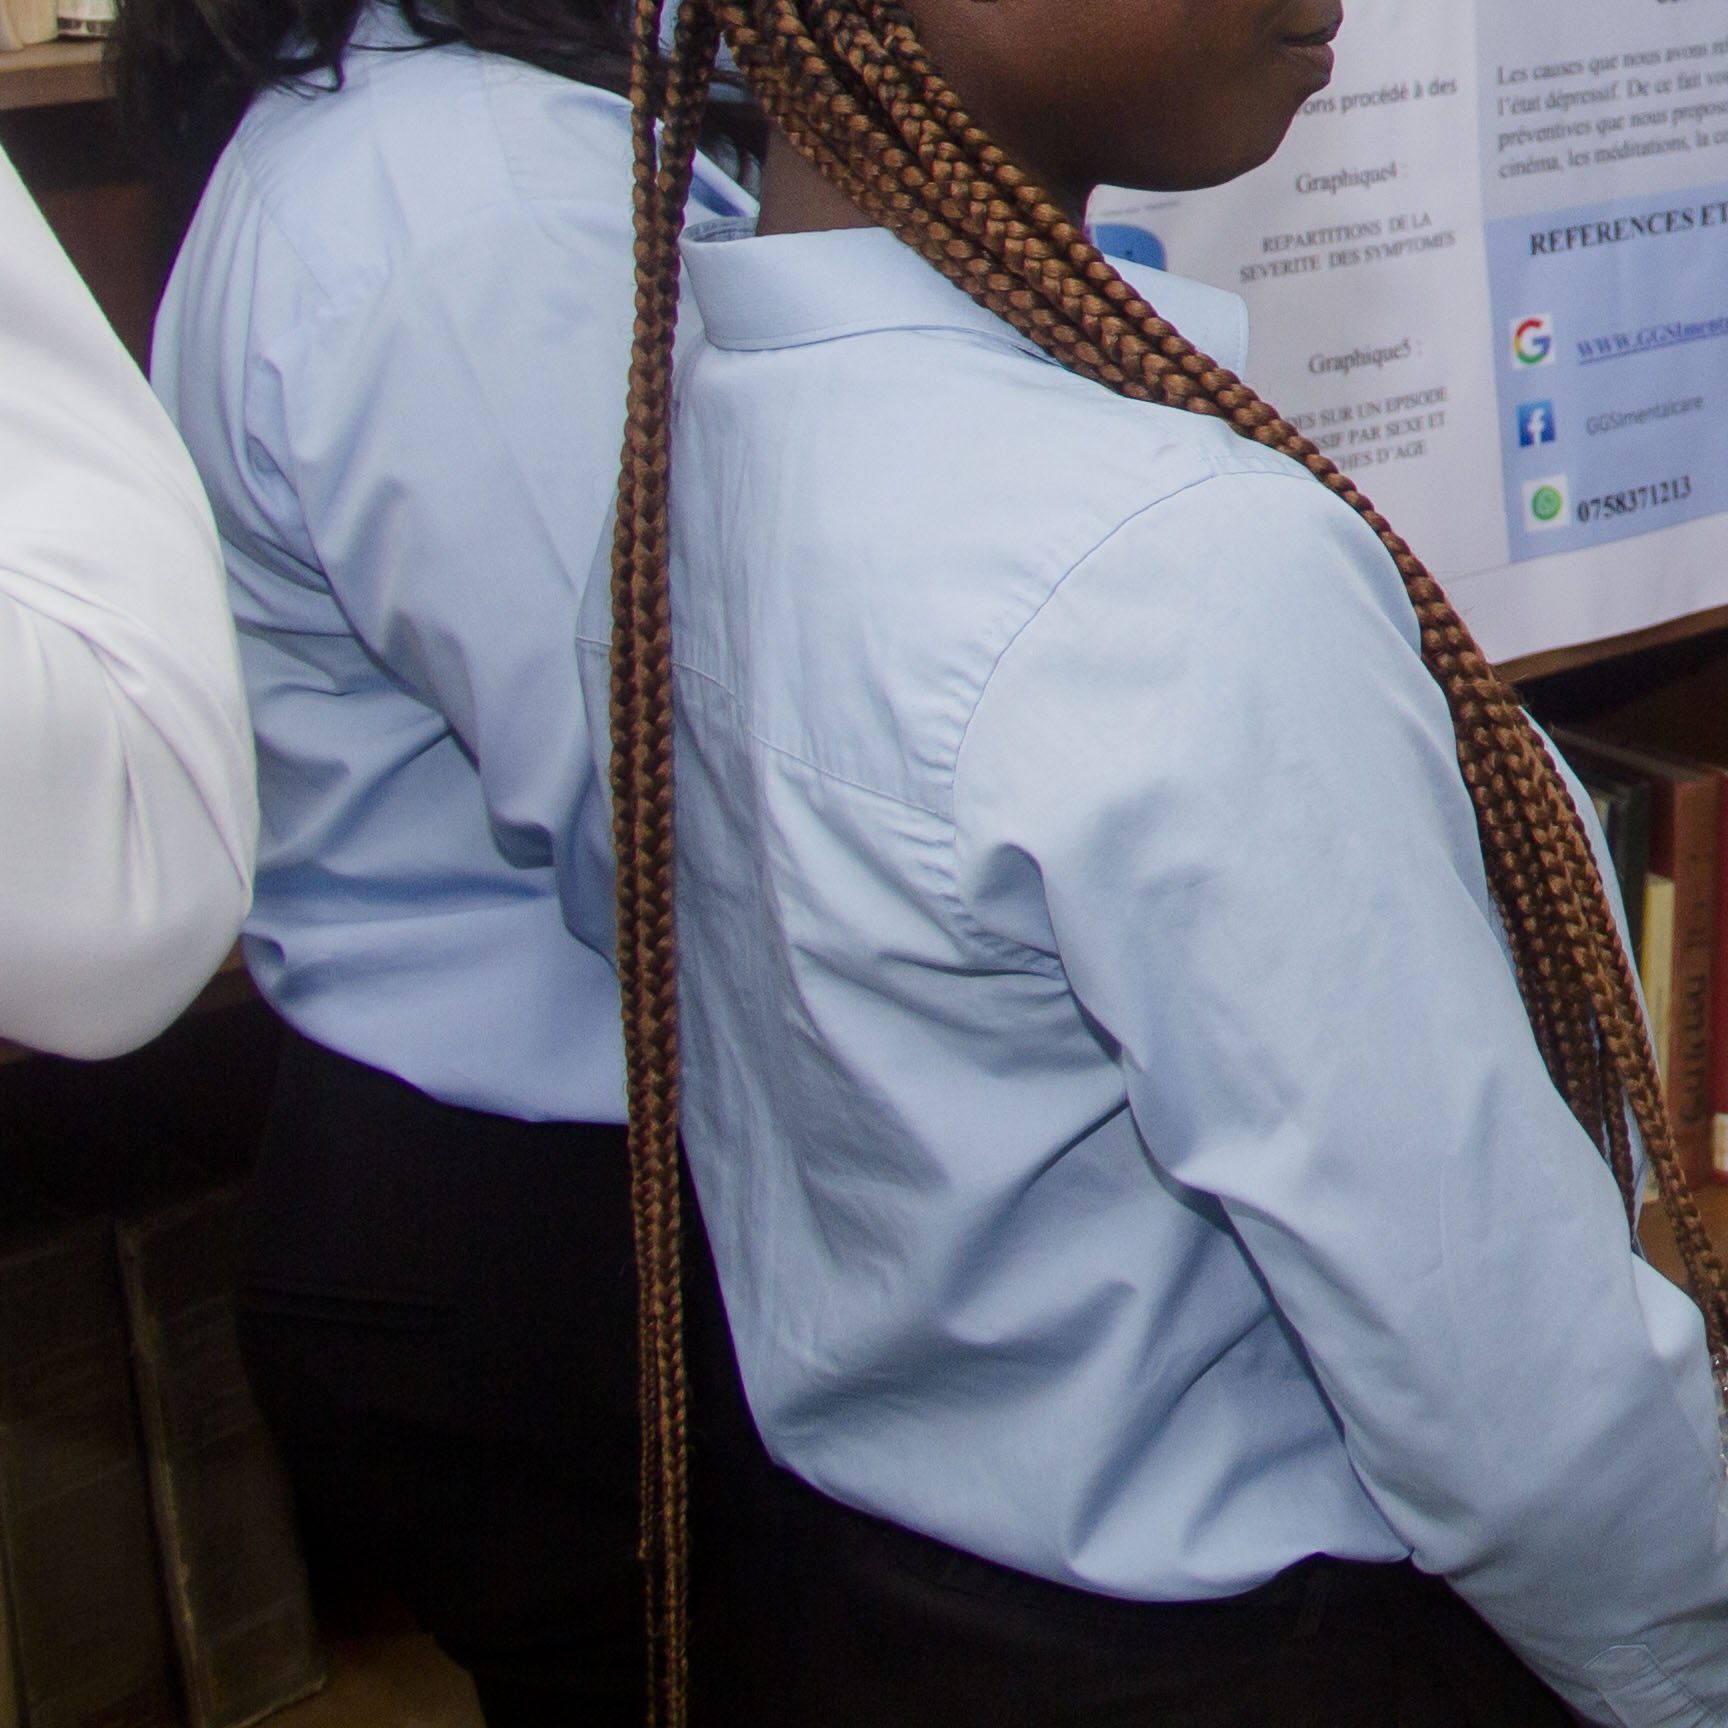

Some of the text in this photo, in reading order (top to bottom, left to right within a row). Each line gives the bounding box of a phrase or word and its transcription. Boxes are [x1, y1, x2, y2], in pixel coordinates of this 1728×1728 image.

[1341, 77, 1457, 114] procédé à des
[1263, 212, 1432, 253] REPARTITIONS DE LA
[1530, 206, 1694, 257] REFERENCES
[1701, 199, 1727, 226] ET
[1240, 231, 1456, 283] SEVERITE DES SYMPTOMES
[1308, 340, 1412, 376] Graphique5
[1319, 386, 1447, 425] SUR UN EPISODE
[1348, 426, 1380, 443] PAR
[1385, 415, 1424, 437] SEXE
[1428, 410, 1446, 427] ET
[1576, 475, 1693, 524] 0758371213
